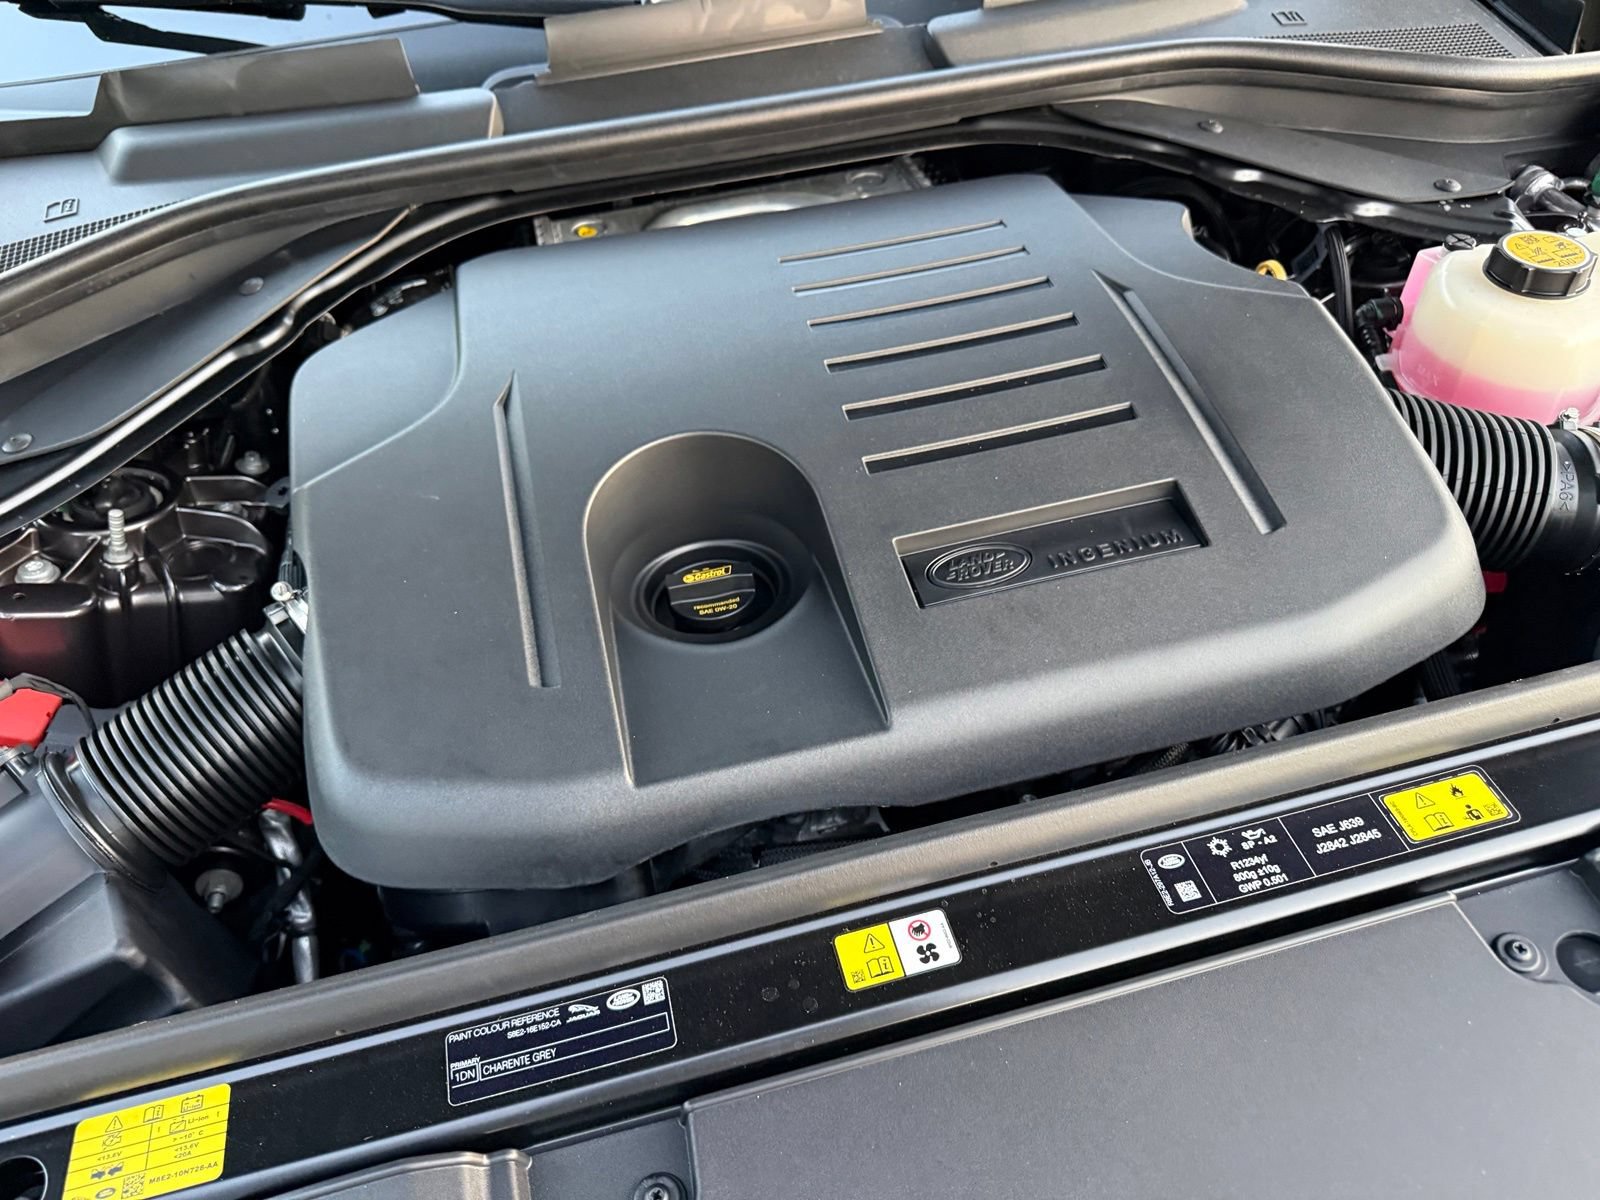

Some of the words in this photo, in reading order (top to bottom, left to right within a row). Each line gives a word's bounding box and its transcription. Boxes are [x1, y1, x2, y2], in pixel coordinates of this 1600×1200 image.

[1047, 528, 1184, 569] INGENIUM
[949, 552, 1001, 571] LAND
[956, 559, 1015, 581] ROVER
[695, 567, 728, 582] Castrol
[699, 608, 714, 616] SAE
[715, 603, 738, 613] 0W-20
[1311, 823, 1339, 838] SAE
[1338, 816, 1365, 831] J639
[1263, 834, 1278, 845] A2
[1316, 837, 1349, 854] J2842
[1349, 828, 1382, 845] J2845
[1230, 853, 1269, 871] R1234yf
[1238, 879, 1263, 893] GWP
[1262, 872, 1289, 887] 0.501
[448, 1030, 473, 1044] PAINT
[473, 1020, 511, 1037] COLOUR
[511, 1007, 561, 1025] REFERENCE
[450, 1056, 481, 1071] PRIMARY
[455, 1069, 476, 1082] 1DN
[482, 1054, 531, 1075] CHARENTE
[532, 1048, 557, 1062] GREY
